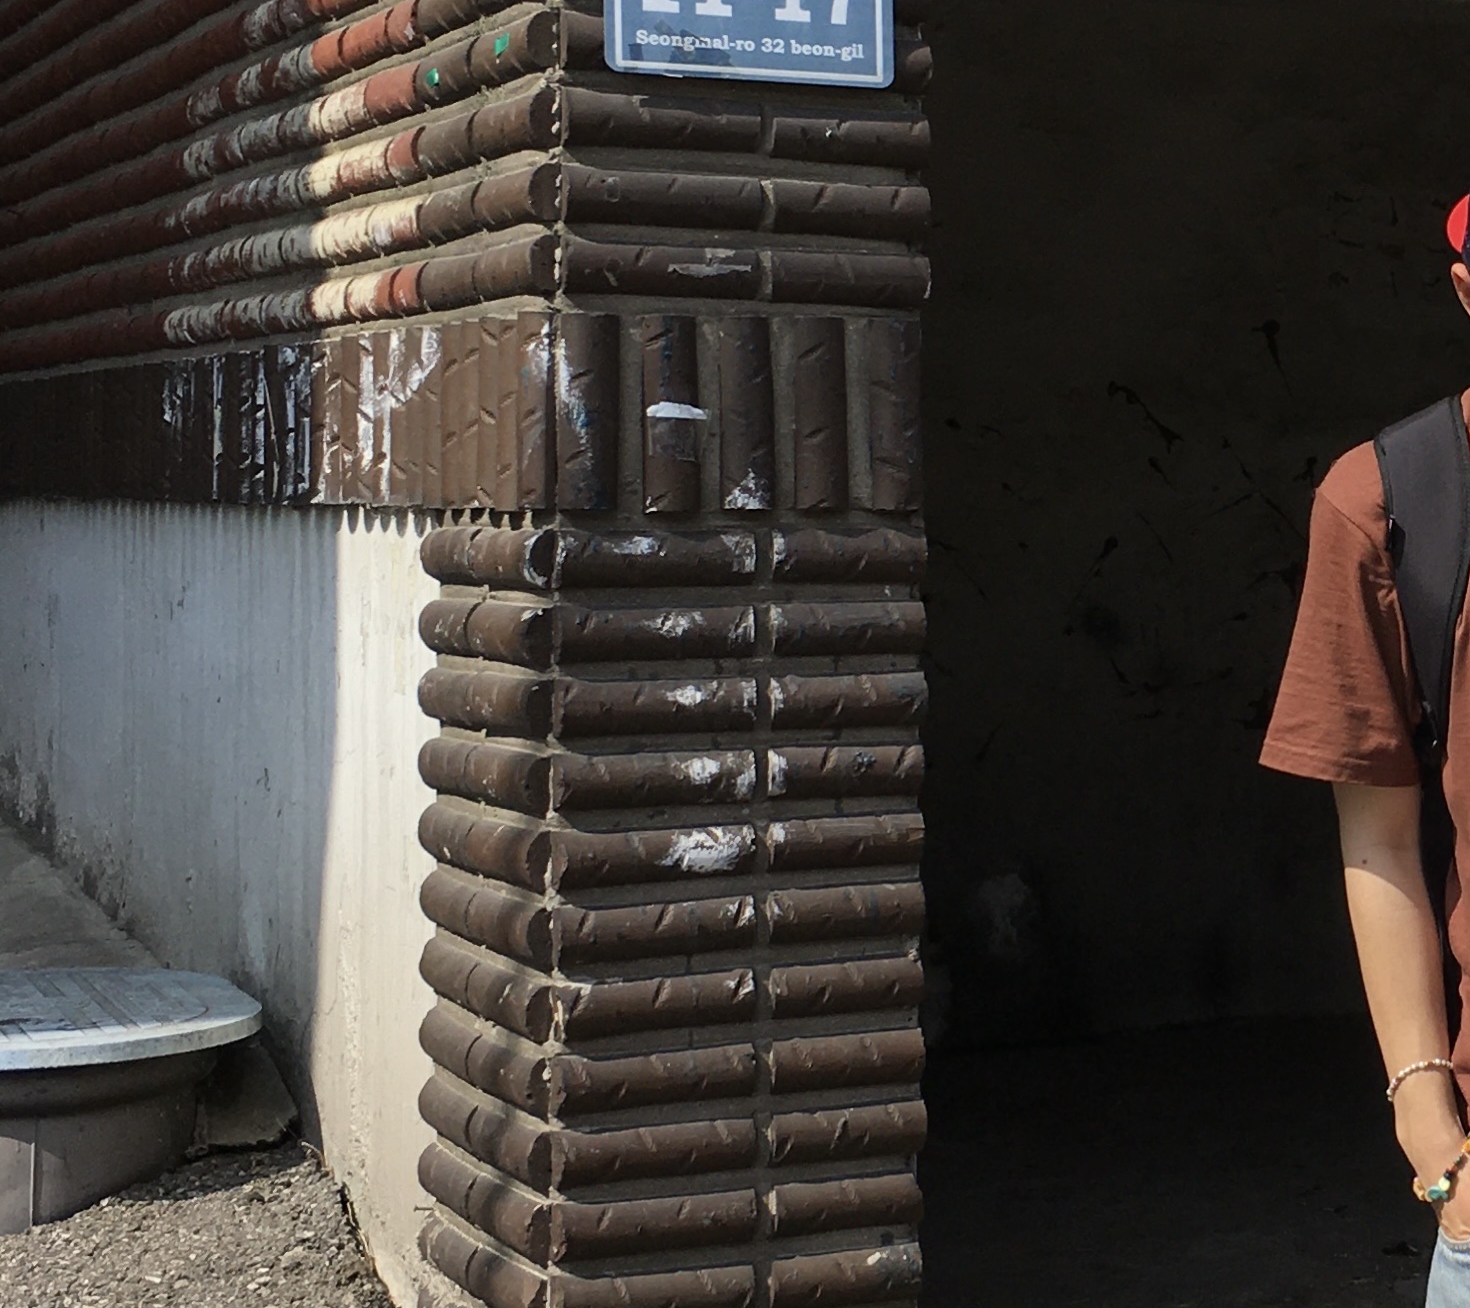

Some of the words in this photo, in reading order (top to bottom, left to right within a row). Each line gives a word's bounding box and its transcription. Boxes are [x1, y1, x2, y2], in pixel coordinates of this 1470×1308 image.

[636, 29, 755, 52] Seongmal-ro
[761, 38, 785, 54] 32
[790, 39, 864, 61] beon-gil
